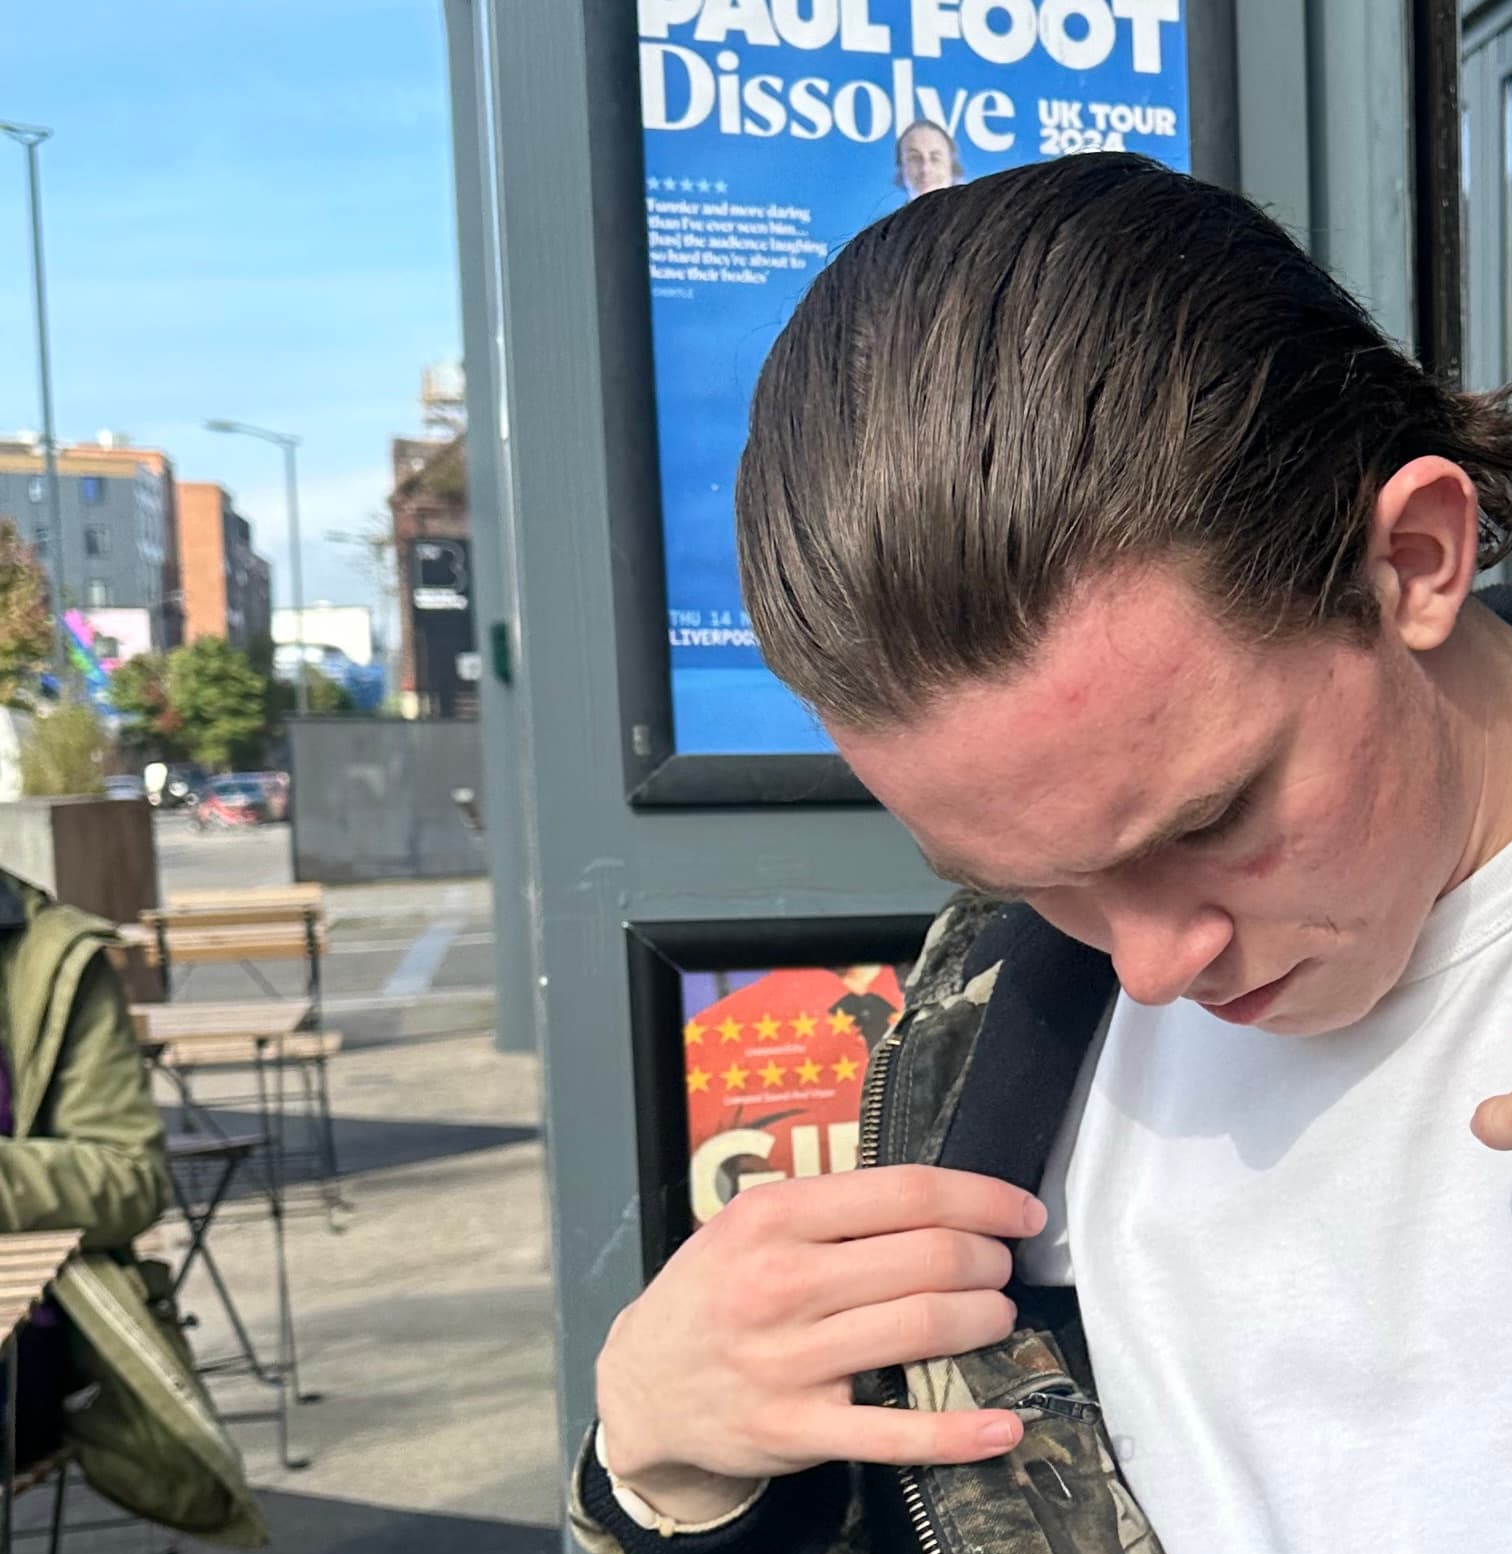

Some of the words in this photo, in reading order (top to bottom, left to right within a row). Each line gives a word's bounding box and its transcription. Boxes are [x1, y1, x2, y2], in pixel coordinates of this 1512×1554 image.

[639, 0, 890, 53] PAUL
[911, 0, 1179, 74] FOOT
[639, 42, 1015, 152] Dissolve
[1038, 99, 1083, 129] UK
[1089, 103, 1177, 136] TOUR
[1039, 128, 1126, 155] 2024
[702, 201, 729, 216] and
[730, 204, 765, 218] more
[767, 204, 811, 223] daring
[648, 215, 681, 230] than
[706, 219, 735, 233] ever
[736, 221, 768, 235] seen
[683, 231, 706, 247] the
[708, 234, 768, 251] audience
[770, 236, 828, 257] laughing
[667, 248, 700, 264] hard
[749, 252, 788, 269] about
[649, 264, 685, 280] leave
[687, 266, 719, 282] their
[669, 609, 700, 626] THU
[711, 610, 731, 626] 14
